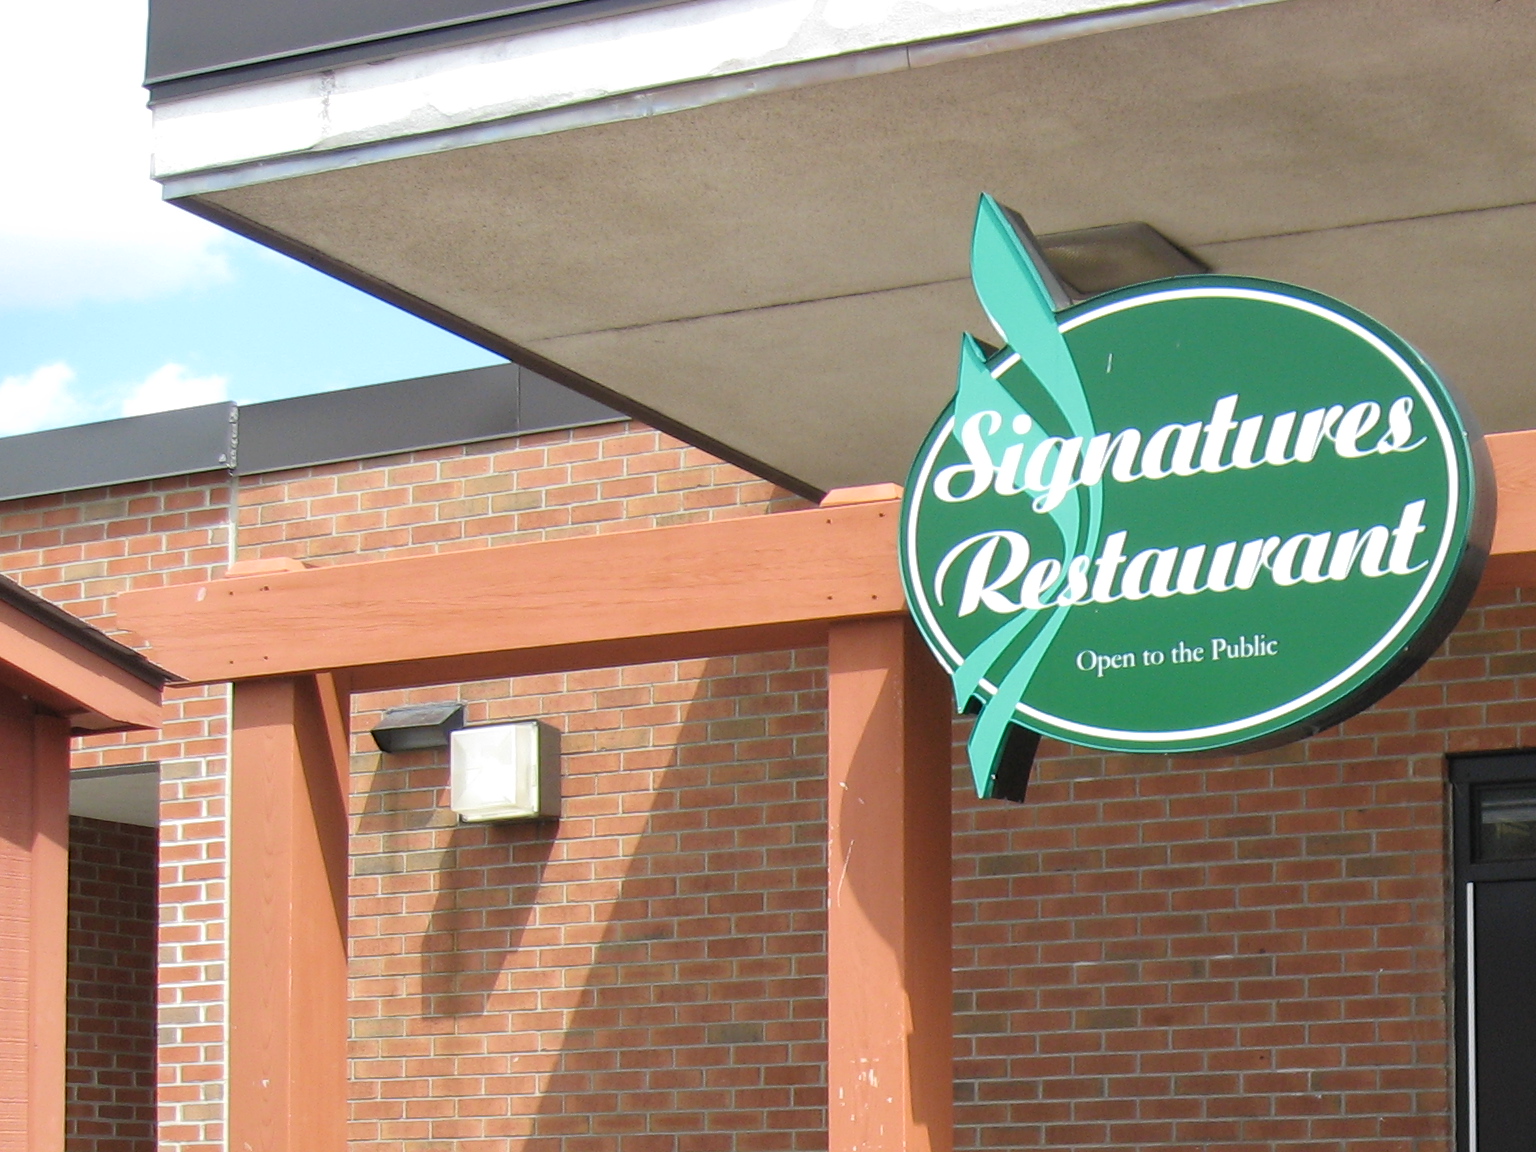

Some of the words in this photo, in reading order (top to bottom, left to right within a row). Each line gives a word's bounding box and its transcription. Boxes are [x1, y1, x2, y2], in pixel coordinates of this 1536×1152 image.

[933, 394, 1428, 514] Signatures
[933, 499, 1430, 618] Restaurant
[1076, 649, 1136, 677] Open
[1143, 647, 1165, 666] to
[1171, 641, 1205, 664] the
[1211, 635, 1279, 661] Public
